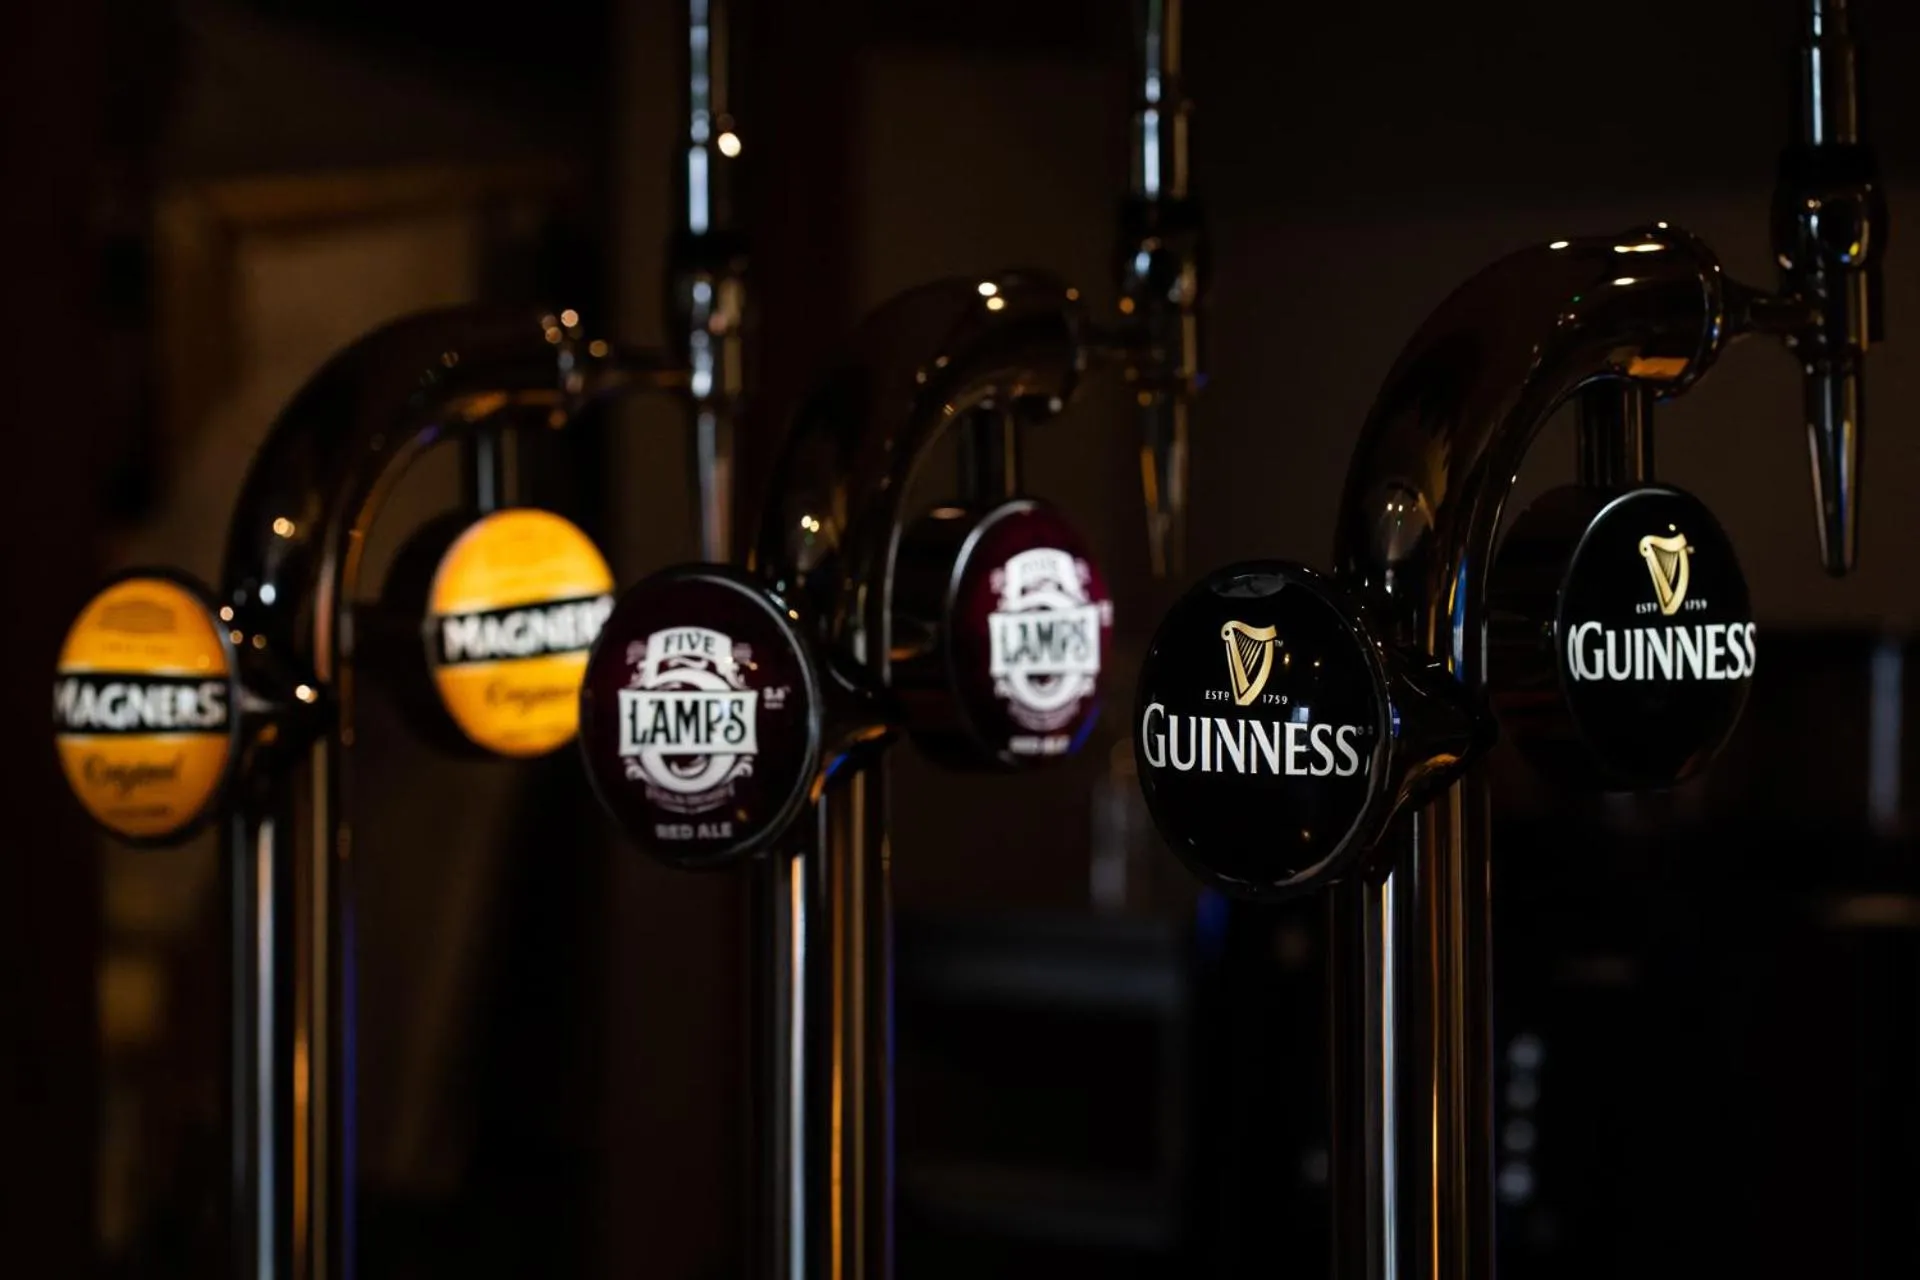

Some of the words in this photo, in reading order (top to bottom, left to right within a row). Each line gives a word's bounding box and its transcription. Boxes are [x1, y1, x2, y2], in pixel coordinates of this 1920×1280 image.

[663, 630, 717, 656] FIVE
[1574, 620, 1757, 681] GUINNESS
[53, 677, 227, 729] MAGNERS
[629, 698, 747, 746] LAMPS
[1262, 693, 1289, 705] 1759
[1142, 702, 1360, 778] GUINNESS
[655, 824, 694, 840] RED
[697, 822, 732, 839] ALE
